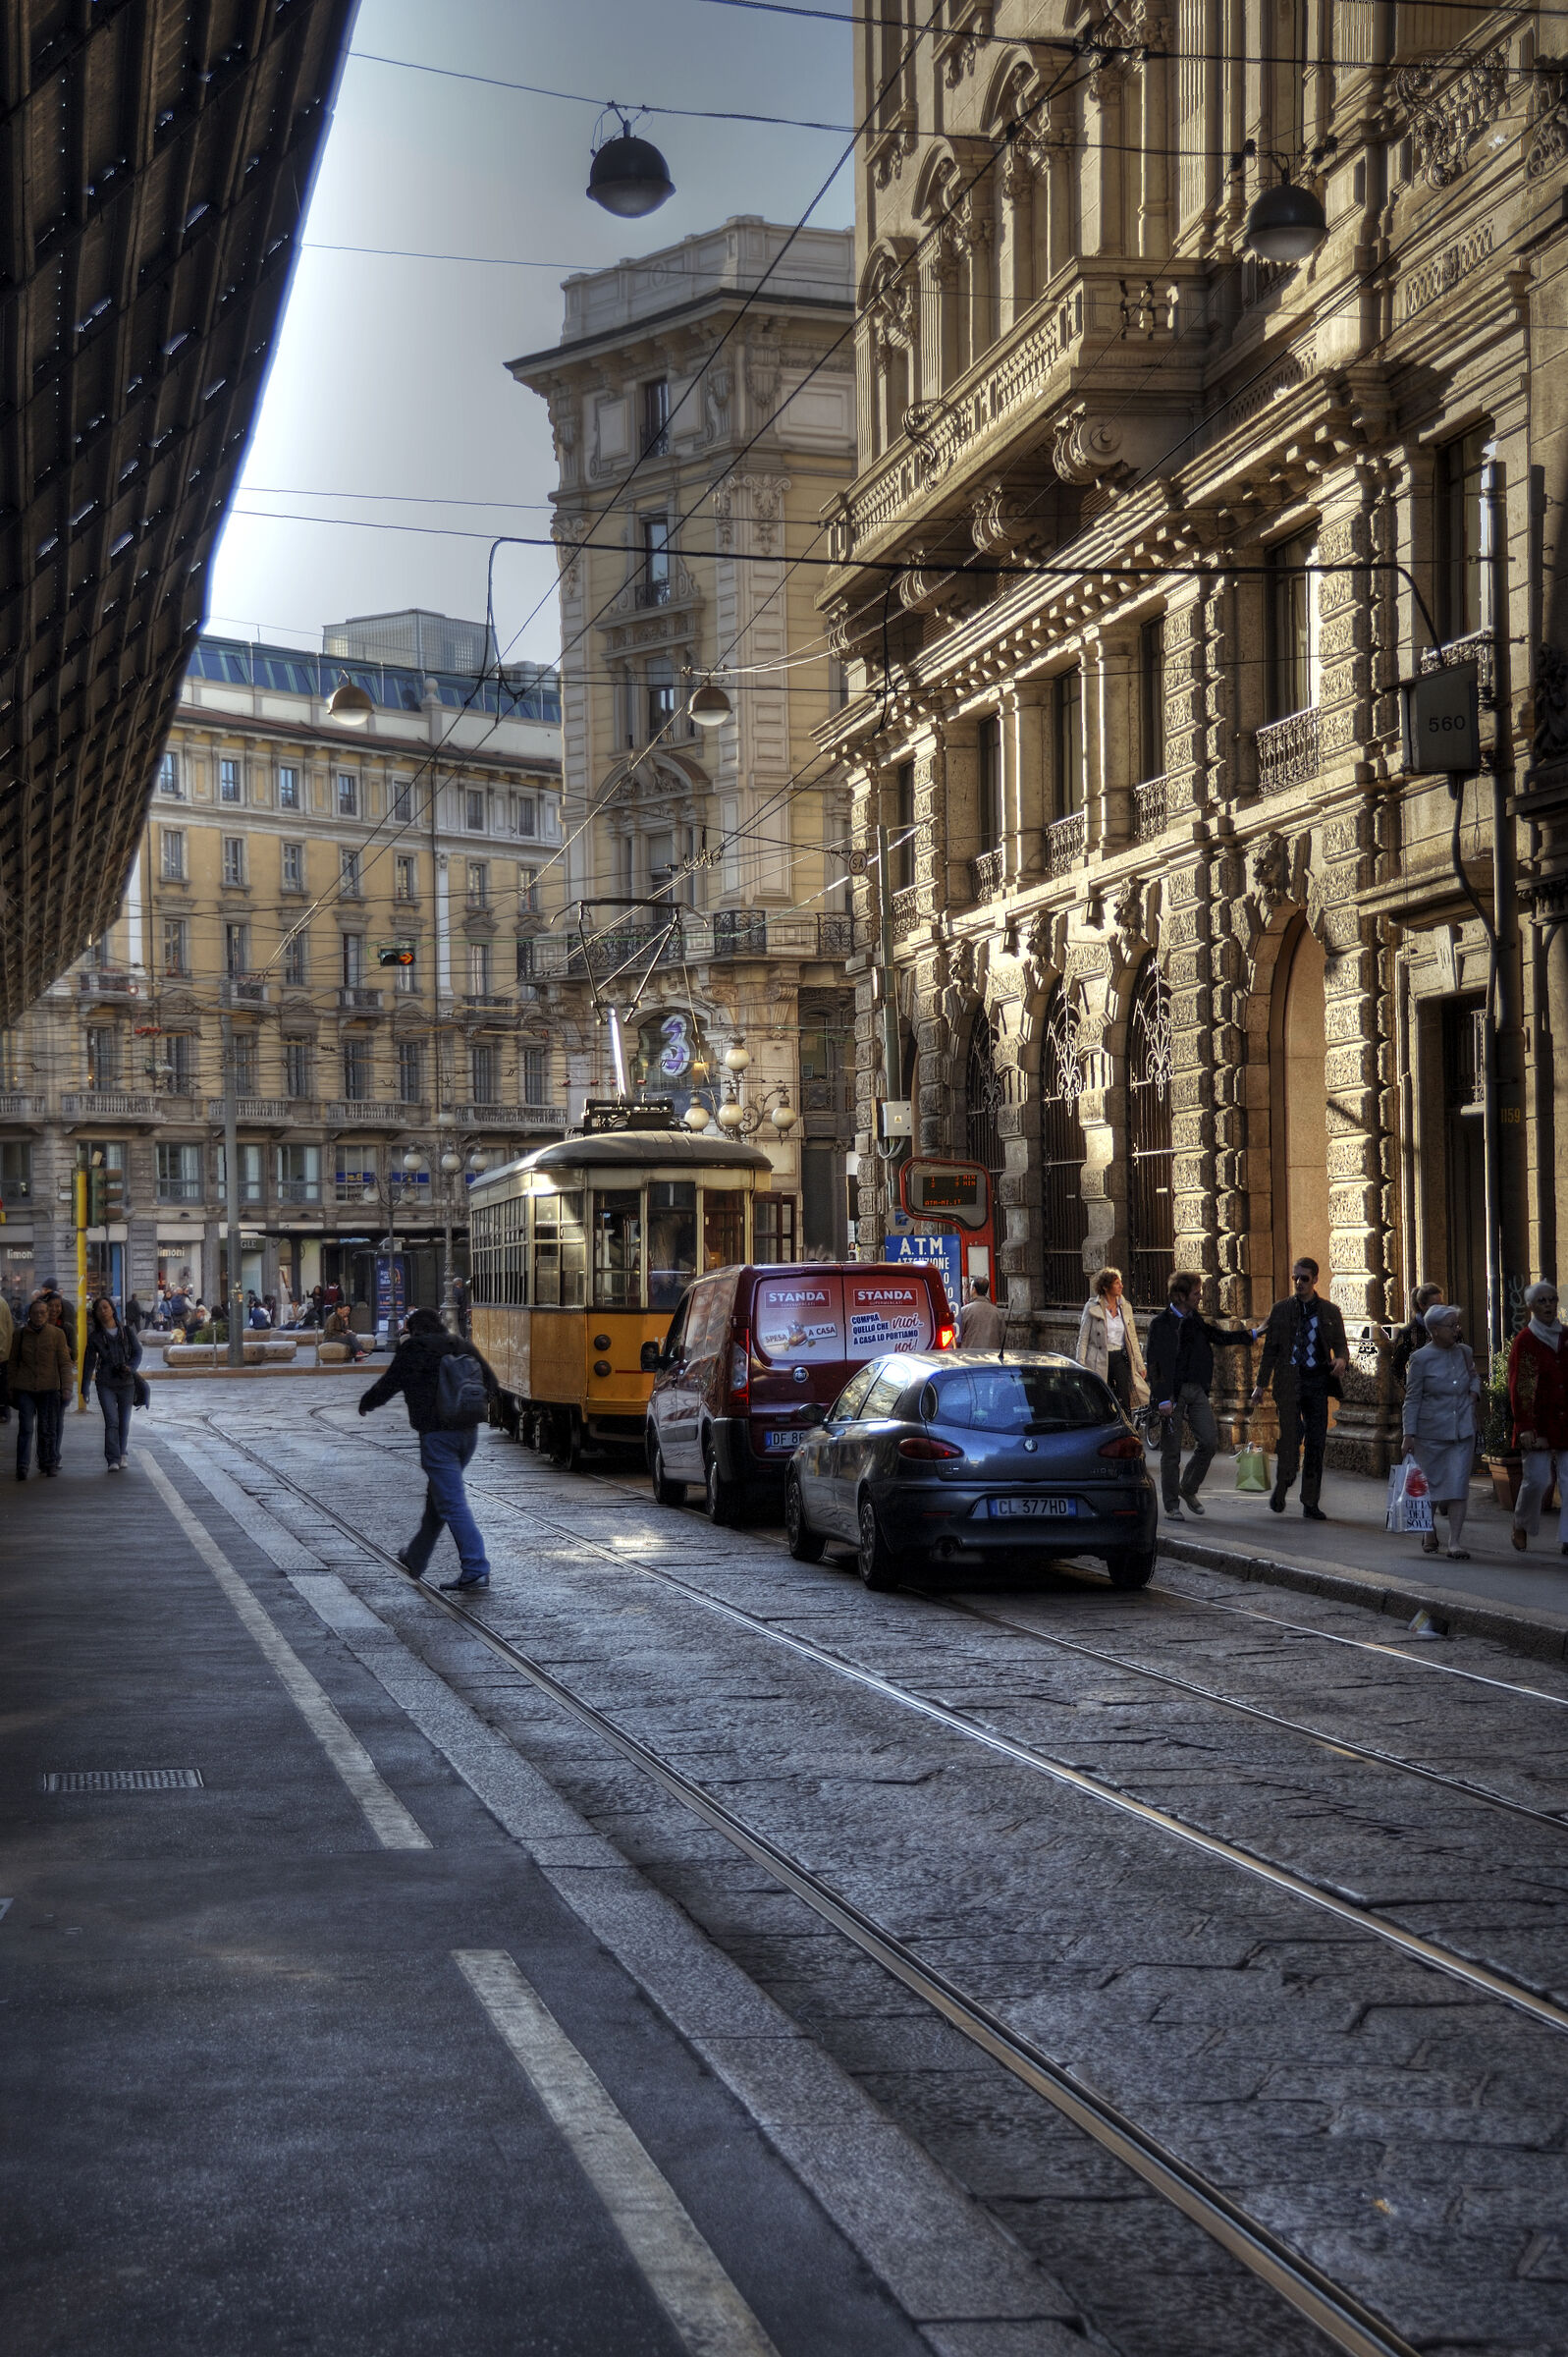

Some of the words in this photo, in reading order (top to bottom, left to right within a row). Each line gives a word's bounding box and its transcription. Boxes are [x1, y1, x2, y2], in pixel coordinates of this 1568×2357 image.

[1430, 715, 1465, 732] 560
[661, 1014, 691, 1077] 3
[1500, 1108, 1520, 1124] 1159
[899, 1236, 946, 1255] A.T.M.
[7, 1249, 34, 1259] limoni
[769, 1291, 826, 1302] STANDA
[857, 1290, 913, 1300] STANDA
[851, 1314, 880, 1324] COMPRA
[765, 1334, 787, 1343] SPESA
[816, 1326, 835, 1336] CASA
[853, 1324, 876, 1335] QUELLO
[877, 1322, 889, 1331] CHE
[853, 1337, 858, 1345] A
[859, 1336, 876, 1344] CASA
[886, 1330, 918, 1341] PORTIAMO
[894, 1339, 918, 1352] noi!
[999, 1500, 1017, 1514] CL
[1022, 1500, 1066, 1513] 377HD
